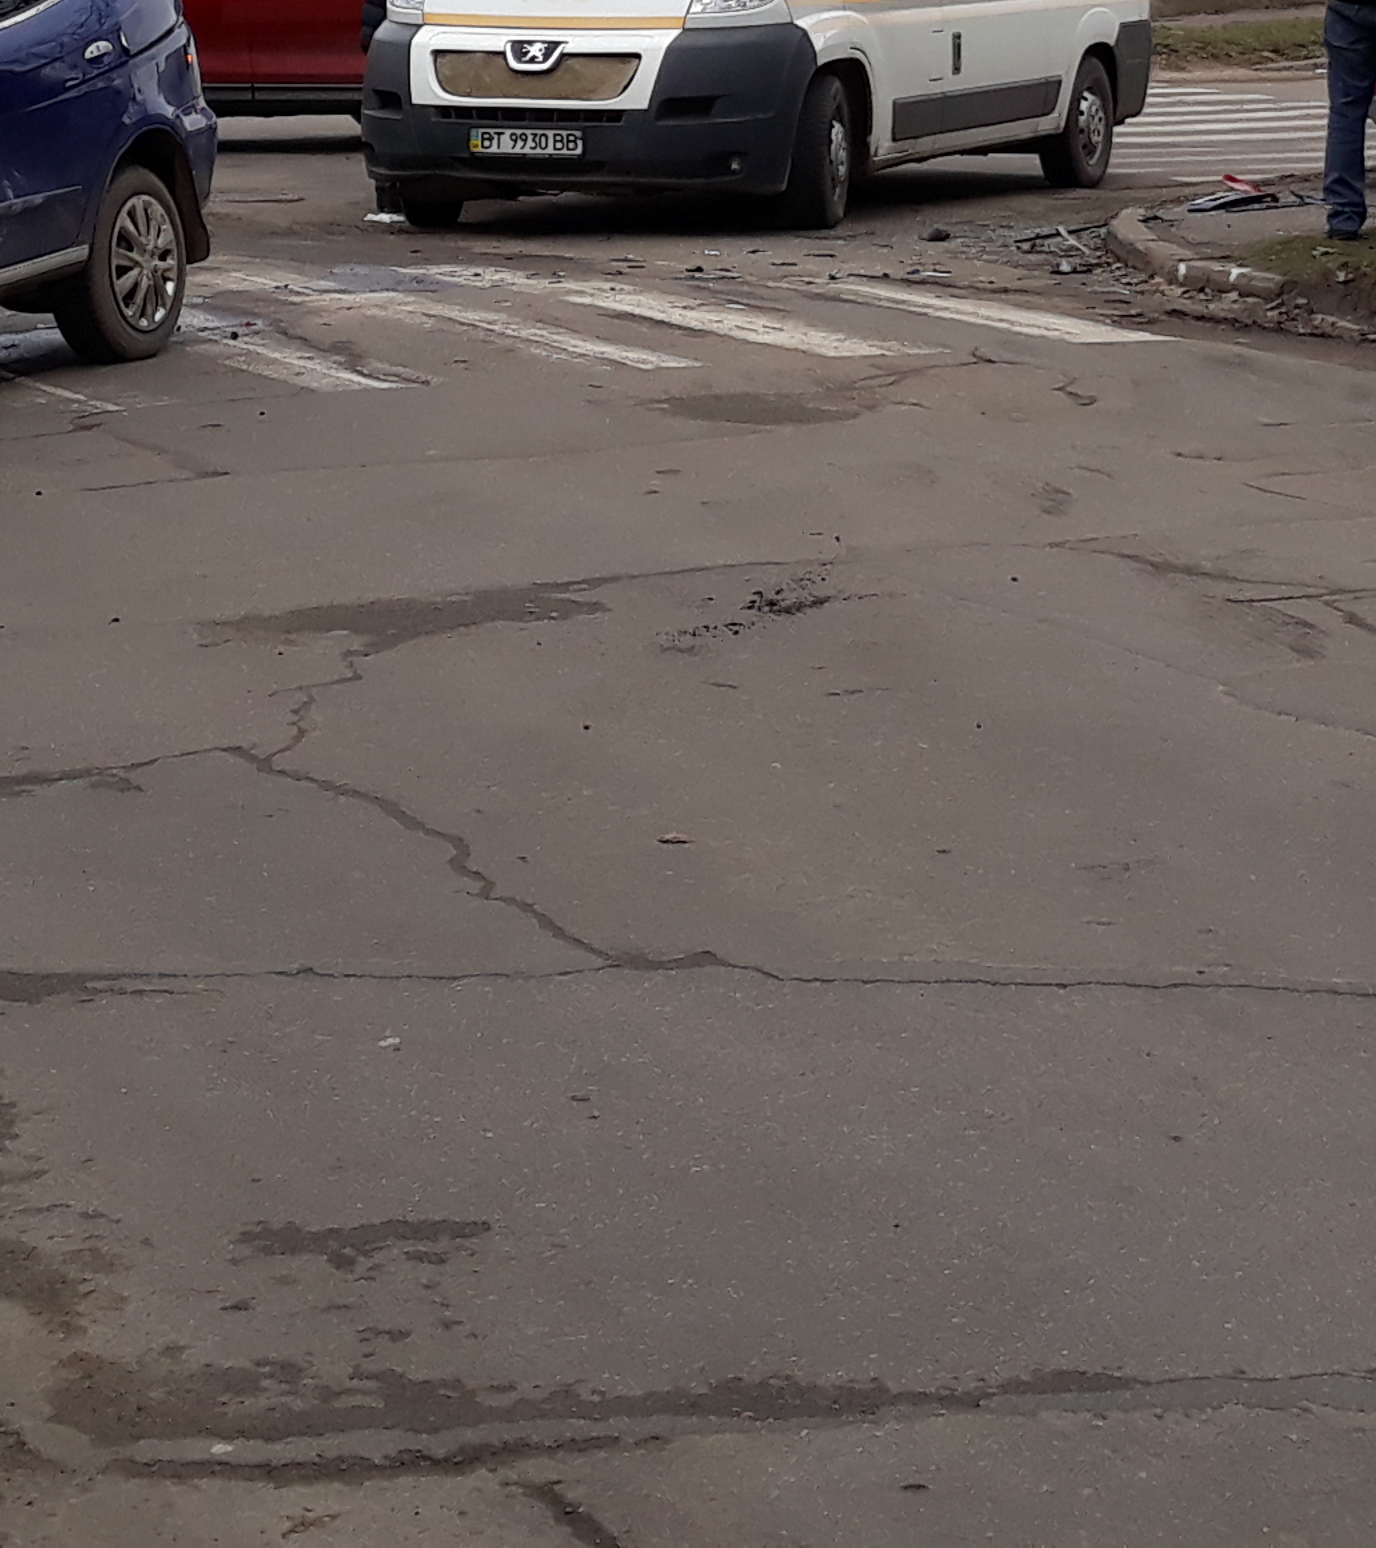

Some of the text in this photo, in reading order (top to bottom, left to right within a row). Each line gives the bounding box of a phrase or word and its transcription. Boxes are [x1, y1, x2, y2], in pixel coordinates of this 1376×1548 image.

[480, 131, 579, 152] BT 9930 BB
